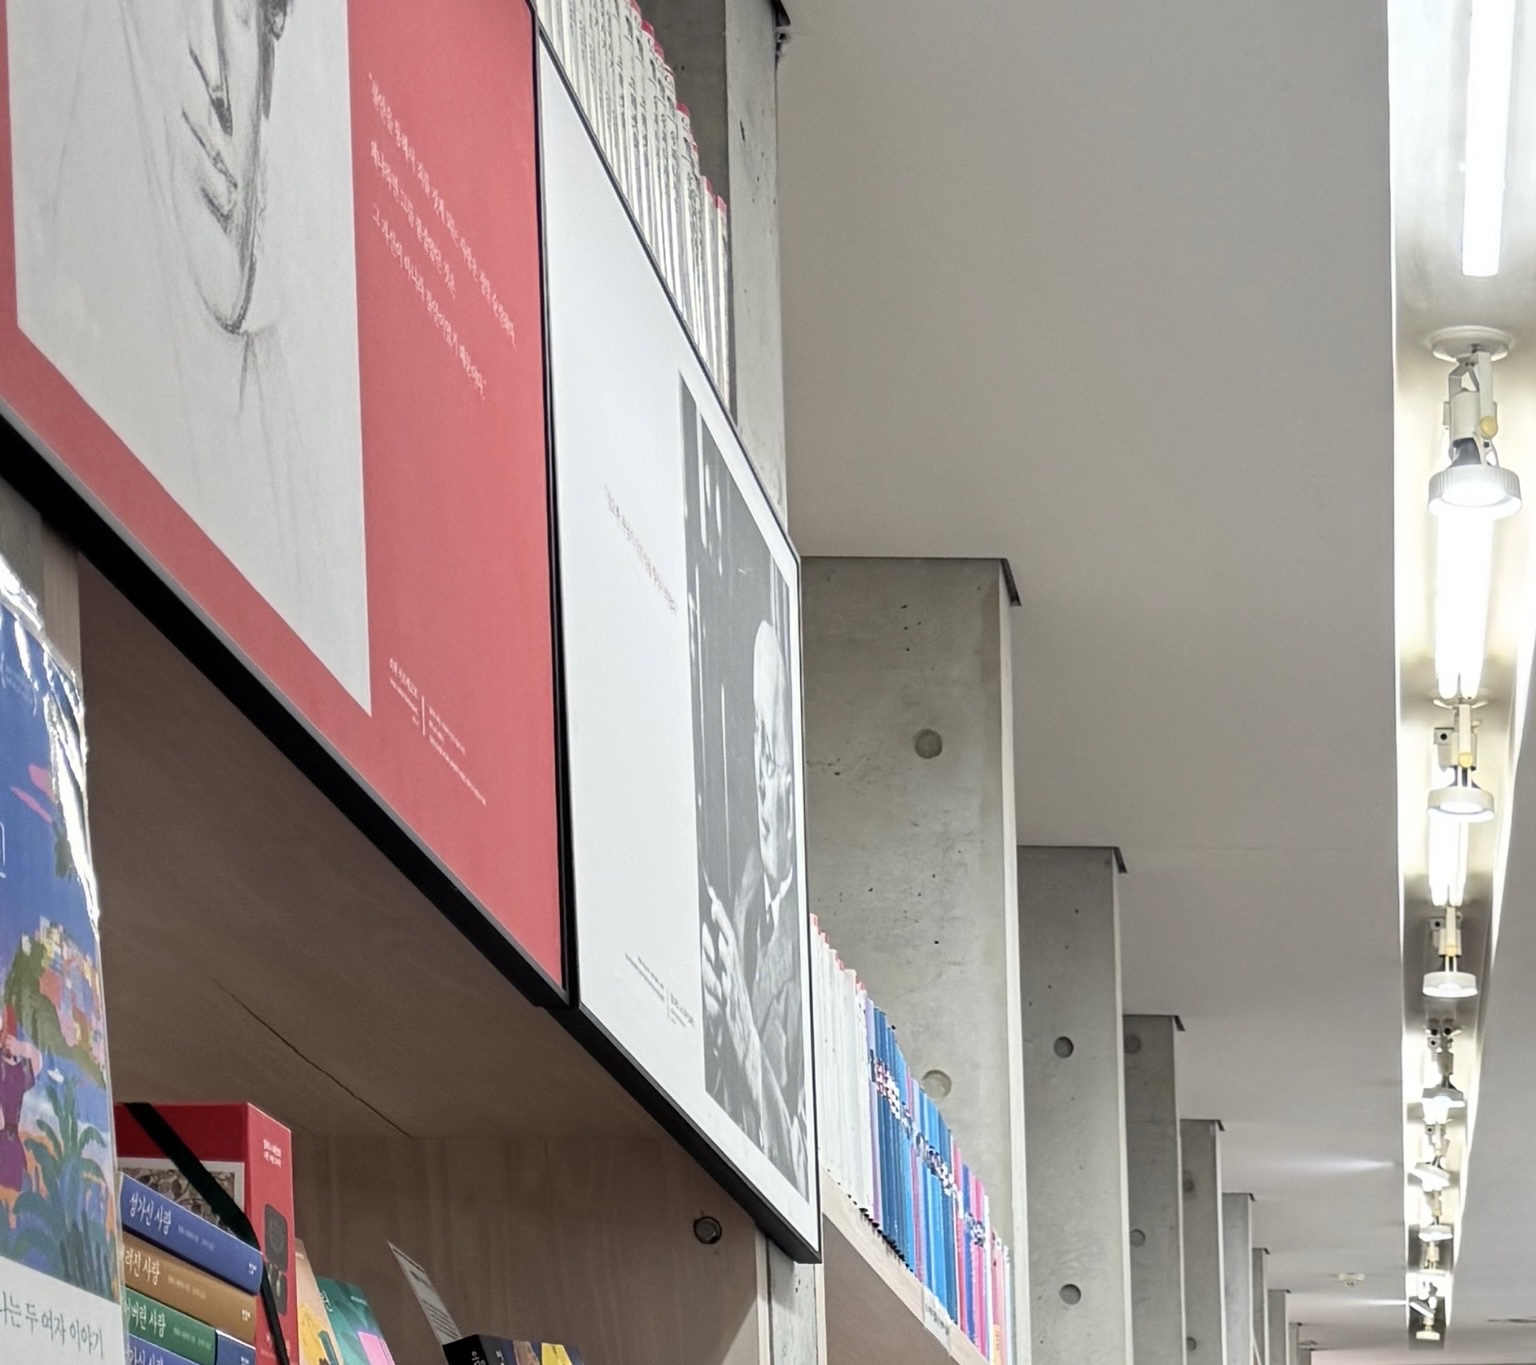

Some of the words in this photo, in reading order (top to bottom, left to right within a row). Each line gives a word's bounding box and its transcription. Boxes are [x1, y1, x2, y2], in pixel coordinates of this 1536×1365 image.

[129, 1193, 155, 1226] 성가신
[154, 1204, 172, 1235] 사랑
[142, 1256, 161, 1286] 사랑
[26, 1301, 38, 1333] 두
[41, 1310, 67, 1348] 여자
[69, 1322, 104, 1358] 이야기
[148, 1310, 167, 1339] 사랑
